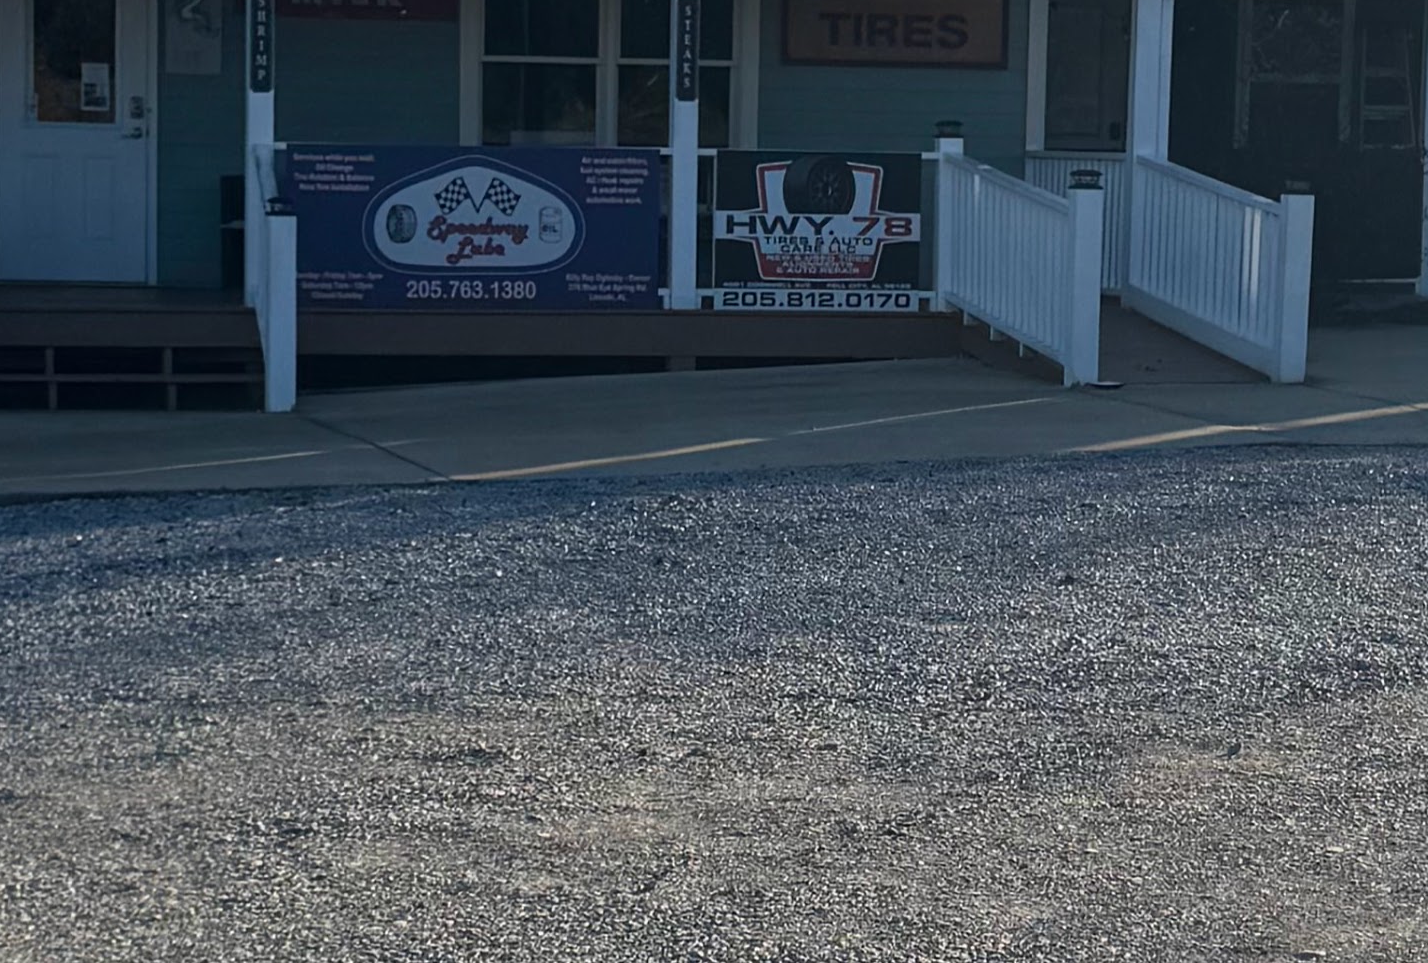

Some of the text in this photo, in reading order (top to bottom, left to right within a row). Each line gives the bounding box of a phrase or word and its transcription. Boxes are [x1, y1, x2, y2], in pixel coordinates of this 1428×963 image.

[819, 12, 969, 49] TIRES
[683, 4, 693, 88] STEAKS
[427, 215, 531, 244] Speedway
[852, 217, 912, 236] 78
[445, 236, 506, 265] Lube
[764, 237, 873, 246] TIRES AUTO
[781, 245, 856, 254] CARE LLC
[406, 280, 537, 300] 205.763.1380
[723, 291, 910, 308] 205.812.0170
